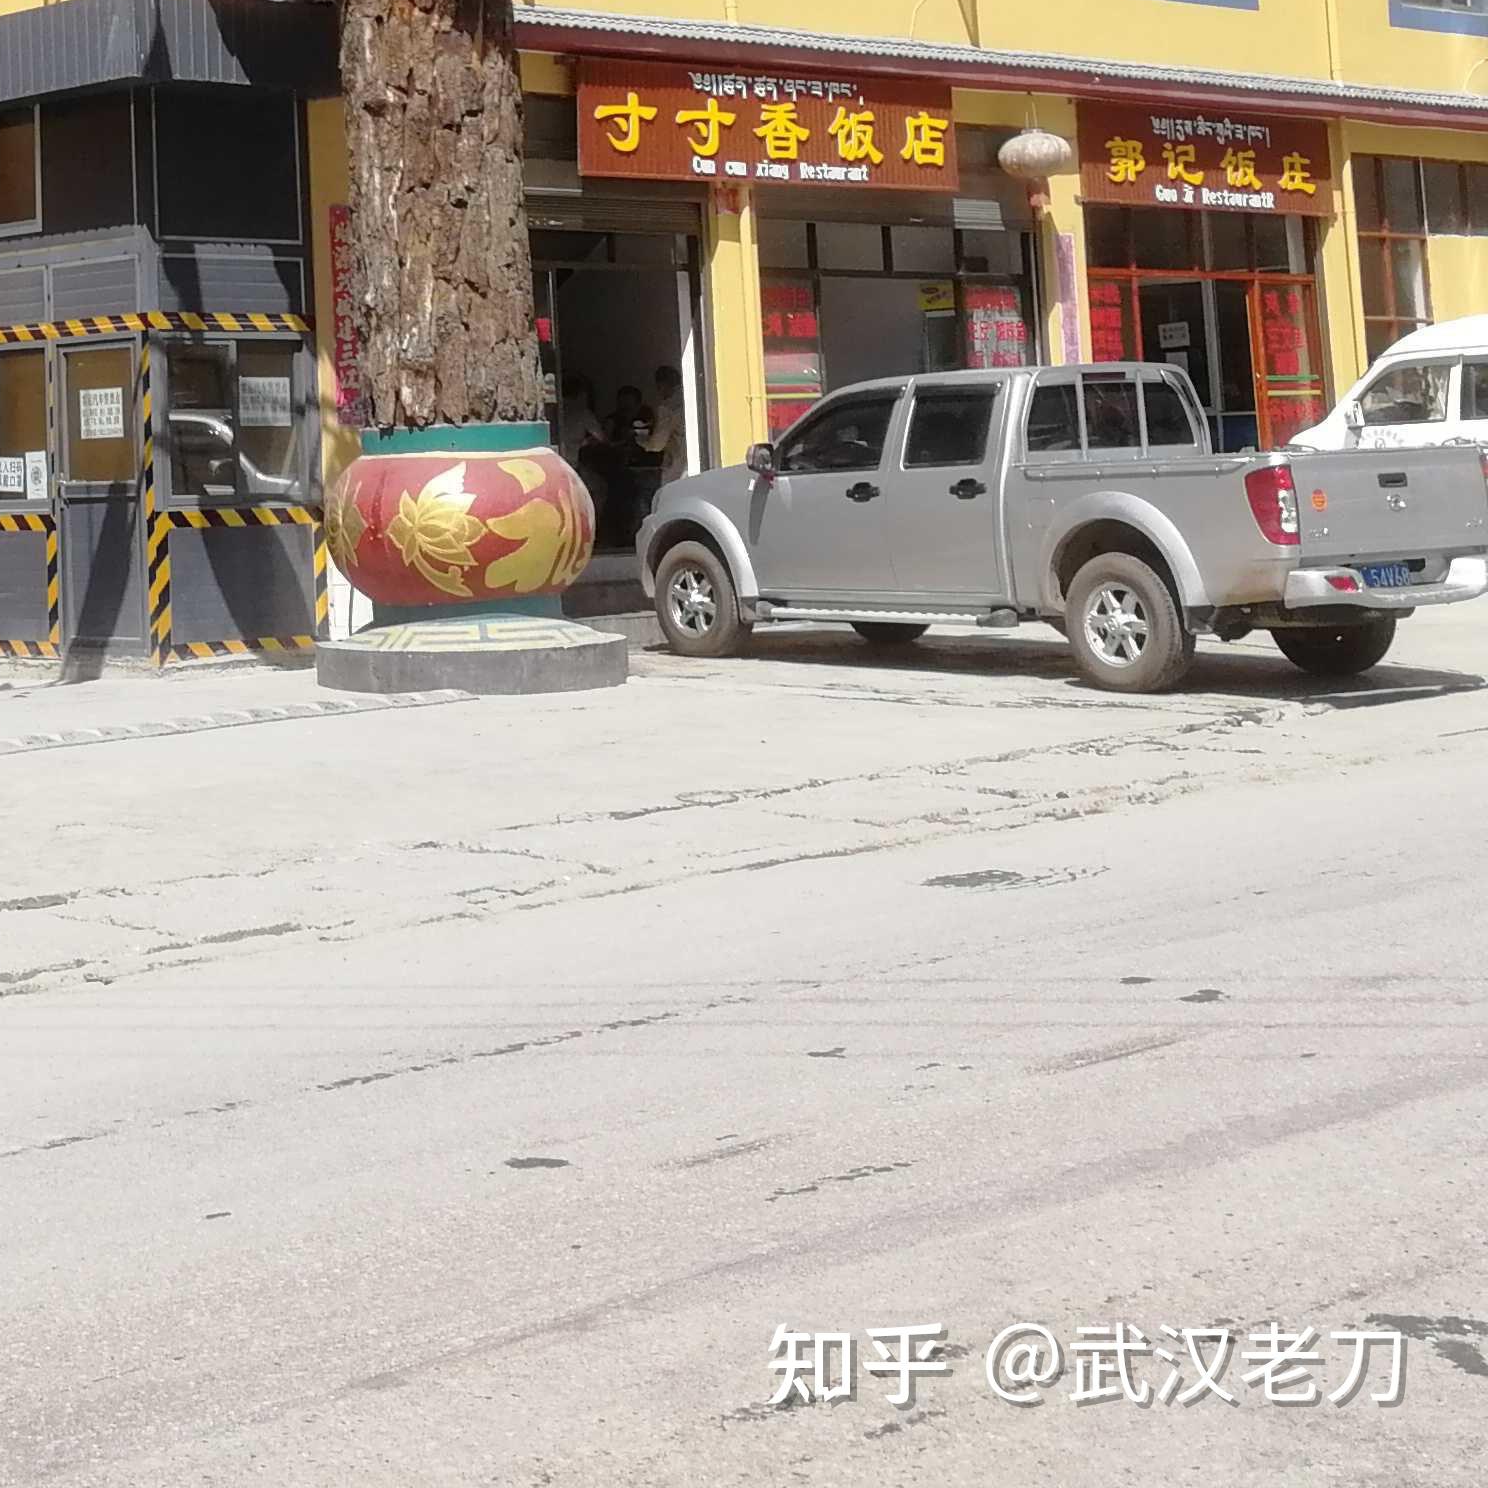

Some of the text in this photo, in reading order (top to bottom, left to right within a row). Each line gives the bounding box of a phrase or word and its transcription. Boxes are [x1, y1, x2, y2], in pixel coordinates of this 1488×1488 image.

[594, 91, 950, 168] 寸寸香饭店
[800, 162, 869, 182] Restaurant
[1105, 135, 1317, 195] 郭记饭庄
